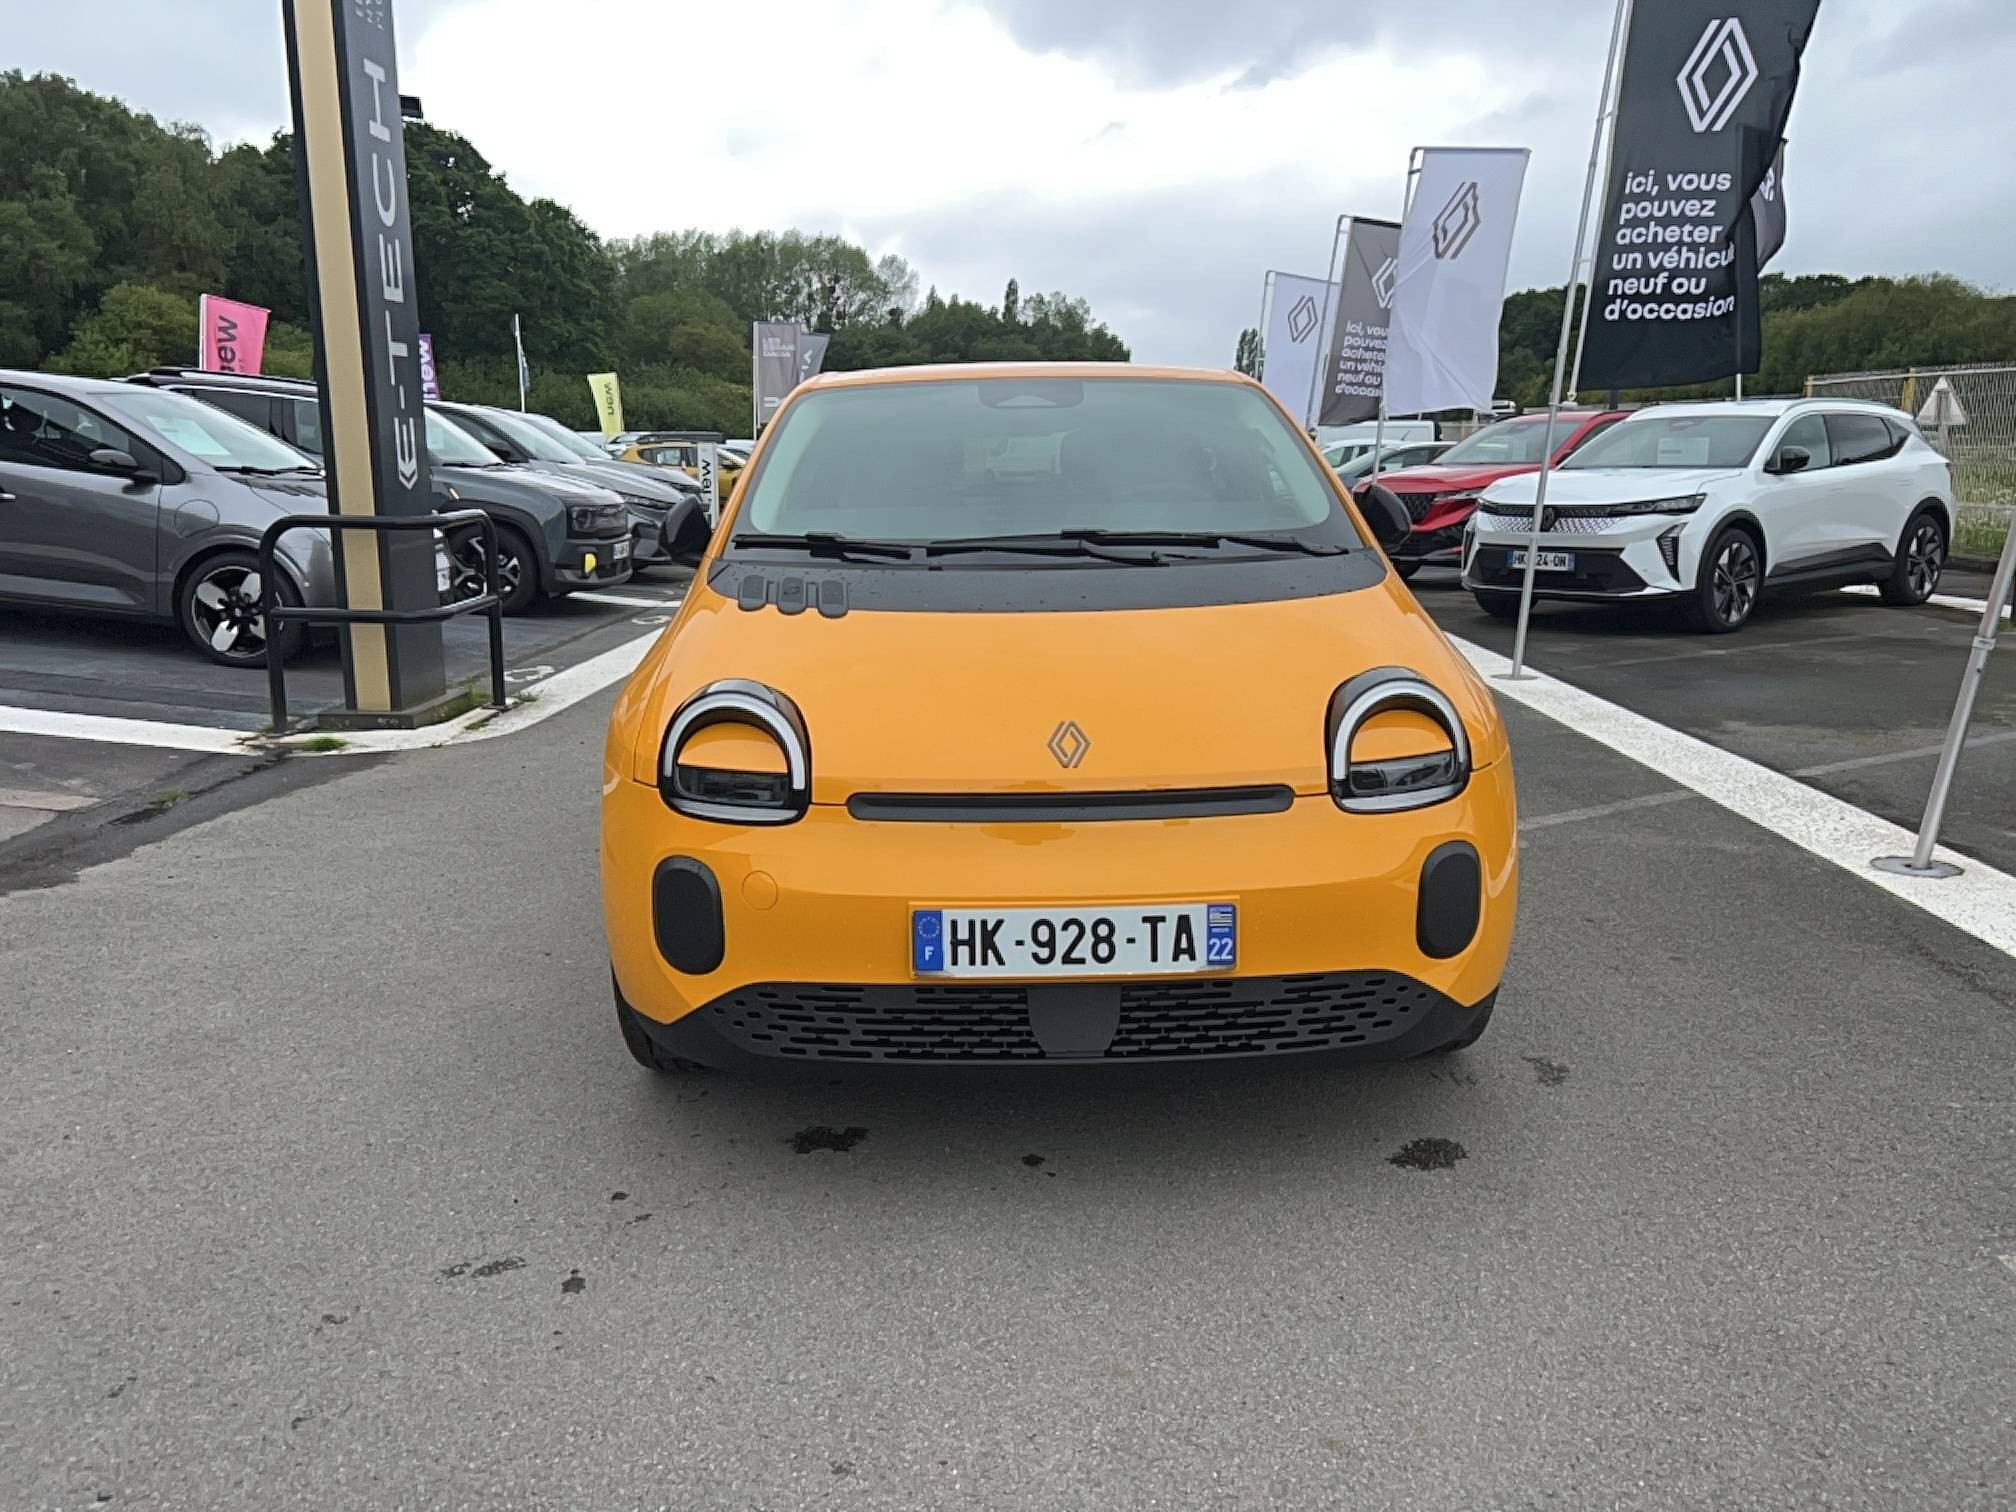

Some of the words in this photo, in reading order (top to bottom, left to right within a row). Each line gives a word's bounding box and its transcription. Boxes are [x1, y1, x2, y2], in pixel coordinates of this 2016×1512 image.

[1625, 169, 1659, 196] ici,
[1667, 172, 1732, 191] vous
[1618, 199, 1716, 225] pouvez
[1616, 221, 1723, 245] acheter
[1612, 252, 1643, 270] un
[1648, 242, 1735, 269] véhicu
[362, 58, 418, 490] E-TECH
[1607, 272, 1669, 296] neuf
[1671, 277, 1707, 294] ou
[1604, 295, 1736, 321] d'occasion
[1366, 325, 1387, 336] vou
[217, 315, 237, 372] ew
[1341, 348, 1386, 361] achete
[1364, 374, 1381, 385] ou
[949, 913, 1197, 967] HK-928-TA
[1208, 937, 1233, 960] 22
[924, 946, 934, 961] F
